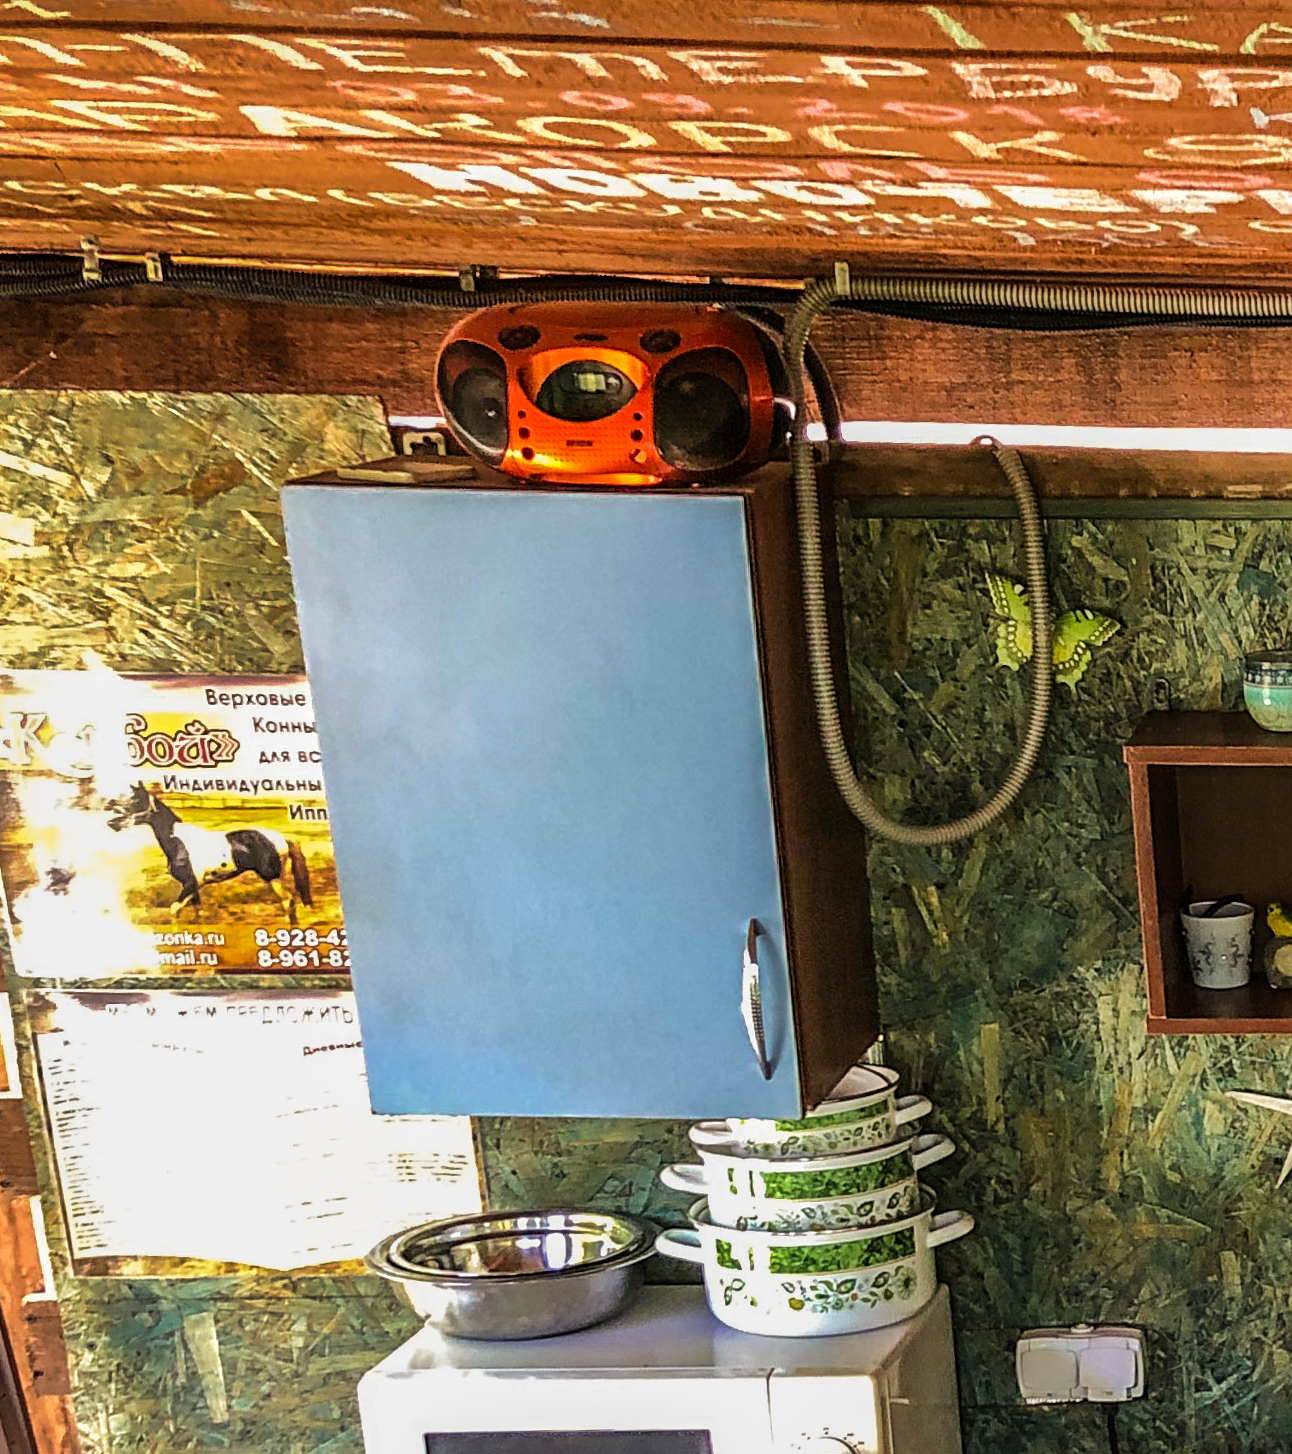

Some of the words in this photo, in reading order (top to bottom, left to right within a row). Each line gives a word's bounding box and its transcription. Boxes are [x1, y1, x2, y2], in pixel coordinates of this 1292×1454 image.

[205, 688, 307, 709] Верховые
[259, 751, 291, 764] для
[163, 774, 322, 795] Индивидуальны
